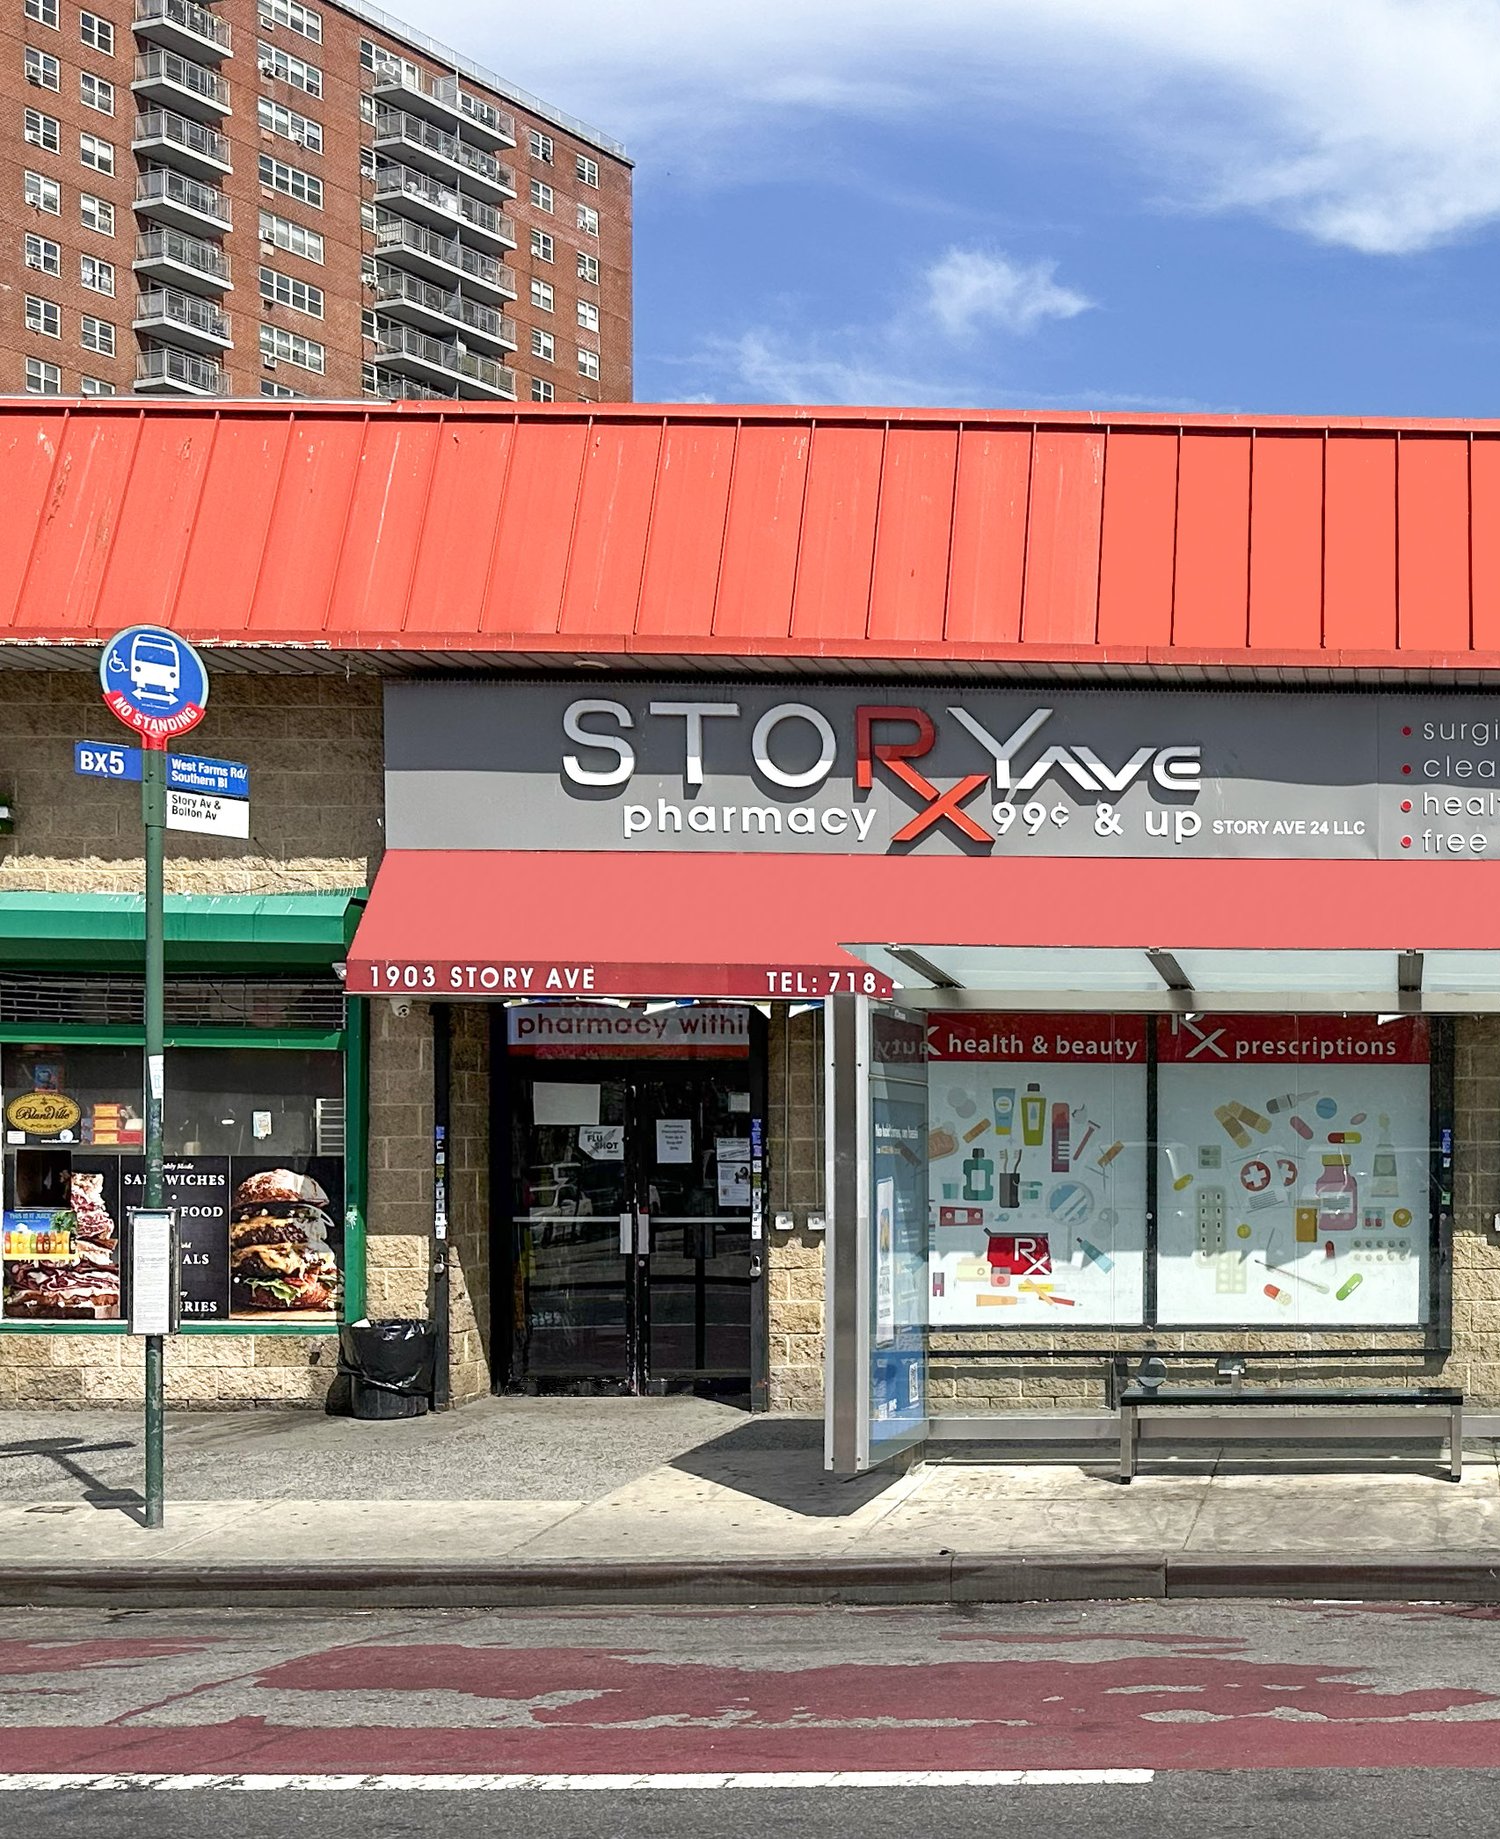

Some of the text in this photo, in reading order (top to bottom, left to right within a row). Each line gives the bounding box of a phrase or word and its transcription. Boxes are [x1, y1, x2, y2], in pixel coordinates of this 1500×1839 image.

[113, 695, 198, 732] NO STANDING
[80, 750, 125, 775] BX5
[171, 758, 248, 780] West Farms Rd/
[171, 771, 228, 788] Southern Bl
[172, 794, 221, 810] Story Av &
[172, 806, 217, 820] Bolton Av
[623, 798, 877, 842] pharmacy
[1094, 804, 1125, 837] &
[1145, 810, 1202, 844] up
[1212, 819, 1366, 837] STORY AVE 24 LLC
[1423, 830, 1488, 853] free
[370, 966, 595, 990] 1903 STORY AVE
[766, 972, 818, 993] TEL:
[518, 1014, 750, 1039] pharmacy withi
[949, 1034, 1023, 1054] health
[1032, 1036, 1048, 1054] &
[1056, 1035, 1138, 1059] beauty
[1236, 1036, 1396, 1059] prescriptions
[124, 1174, 225, 1186] SAWICHES
[180, 1206, 224, 1218] FOOD
